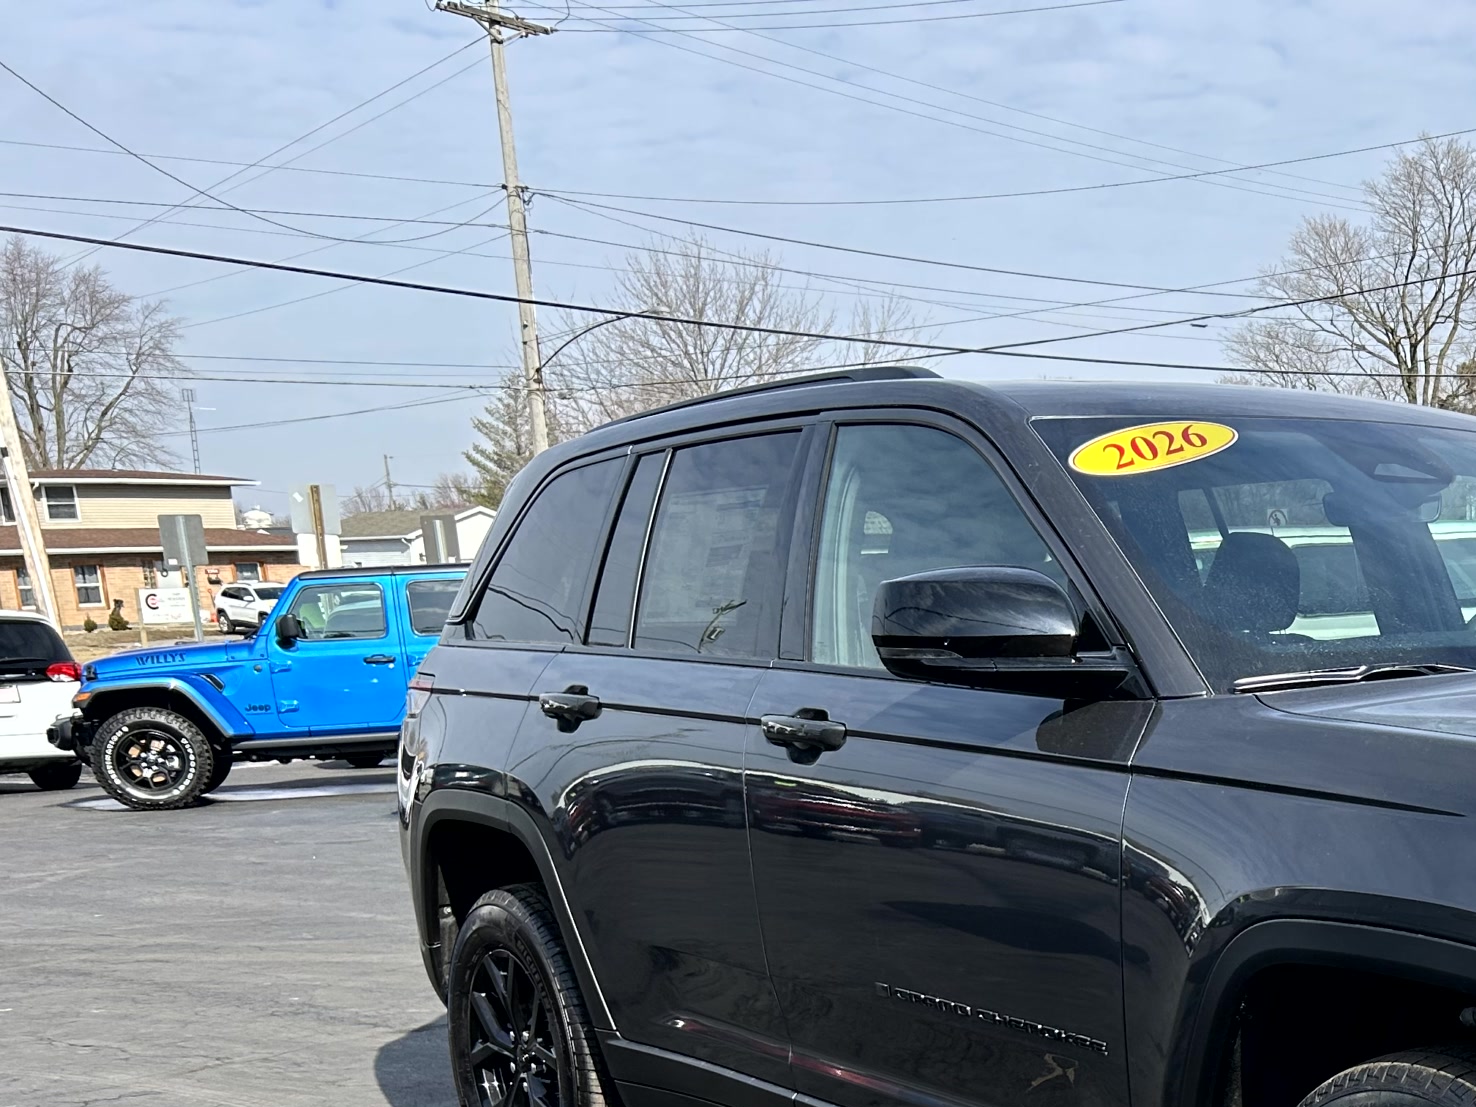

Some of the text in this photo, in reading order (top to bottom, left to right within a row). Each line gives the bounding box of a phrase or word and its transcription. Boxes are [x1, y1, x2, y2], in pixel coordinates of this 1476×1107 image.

[1102, 424, 1208, 471] 2026
[135, 652, 187, 666] WILLYS
[244, 703, 272, 713] Jeep
[976, 1008, 1109, 1057] CHEROKEE
